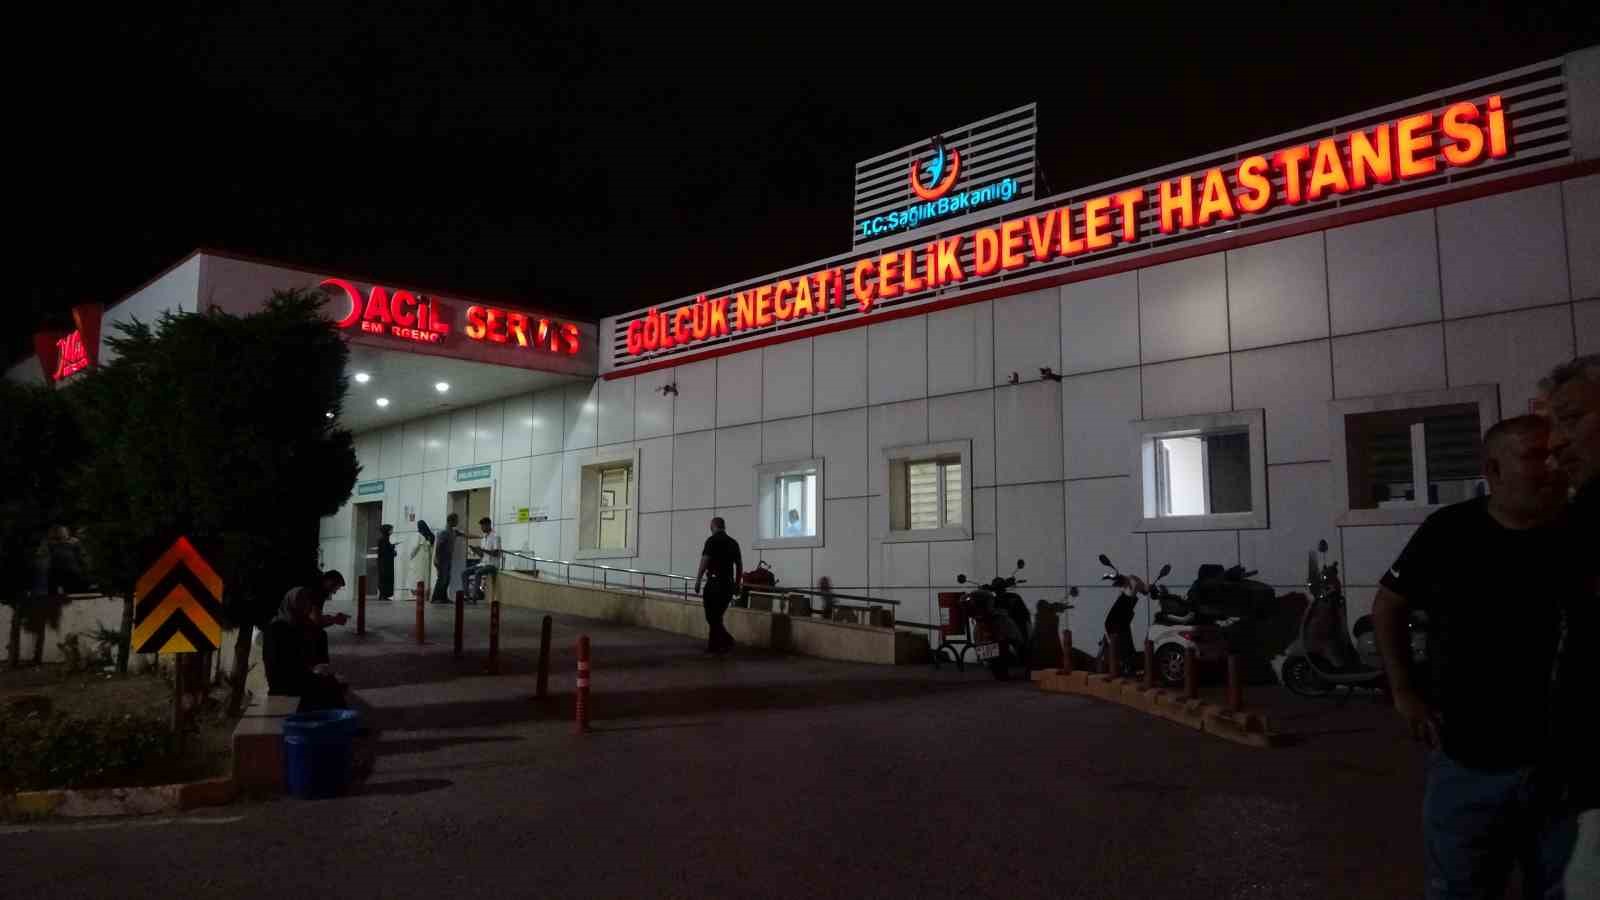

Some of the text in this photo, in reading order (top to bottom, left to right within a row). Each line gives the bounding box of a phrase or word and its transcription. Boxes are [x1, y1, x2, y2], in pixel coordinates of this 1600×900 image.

[626, 95, 1508, 356] GÖLCÜK NECATİ ÇELİK DEVLET HASTANESİ
[938, 178, 1018, 214] Bakanlığı
